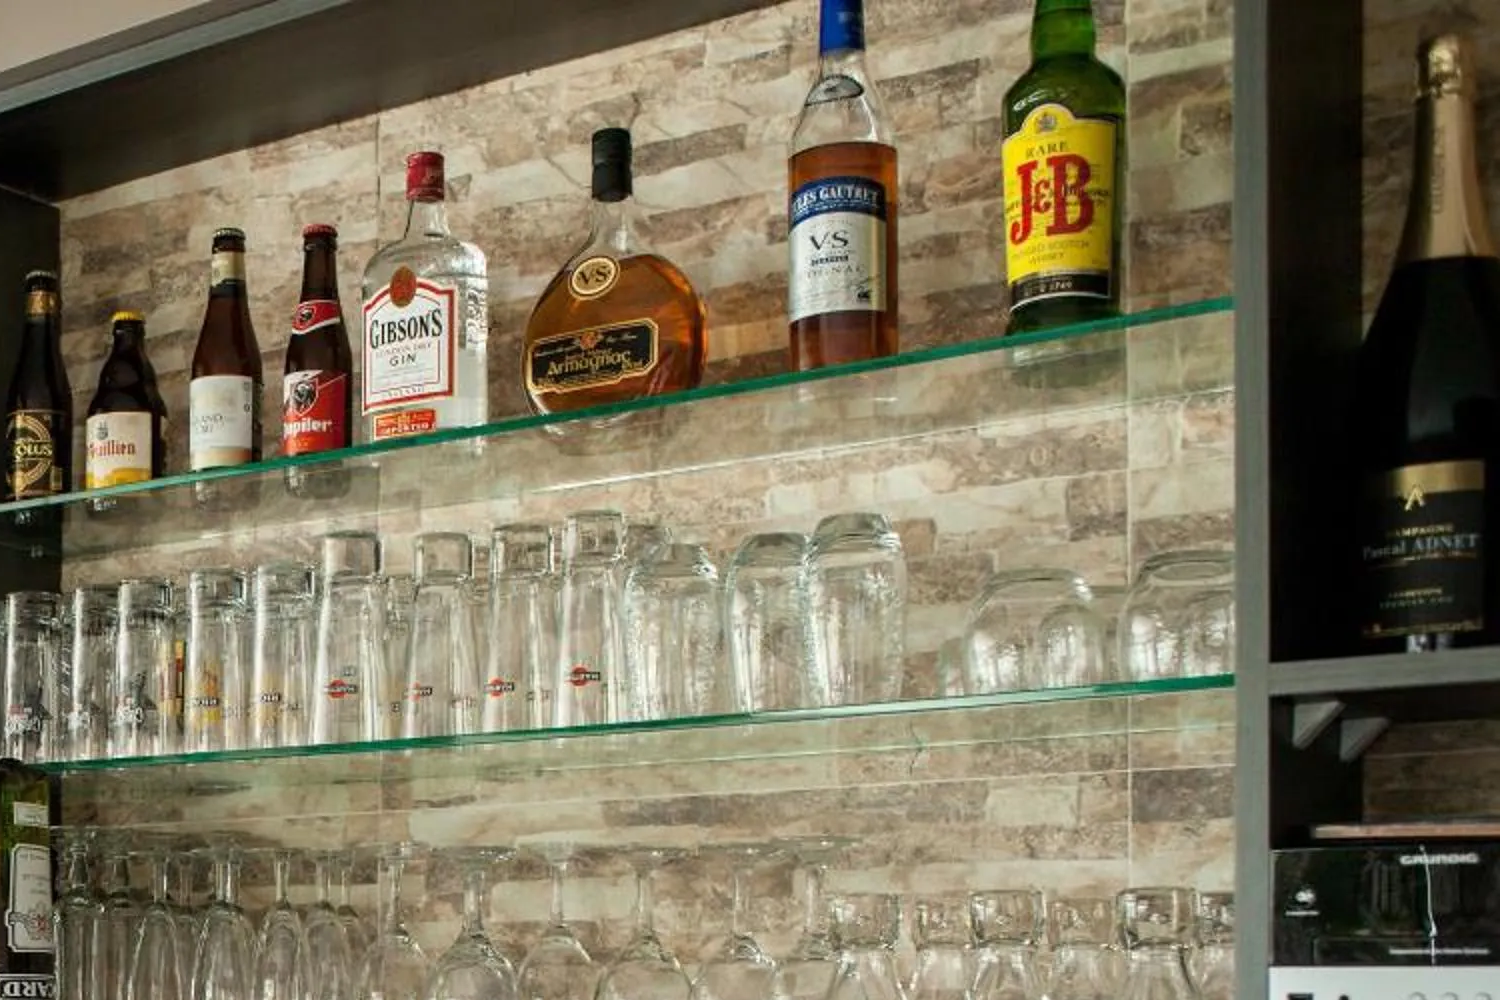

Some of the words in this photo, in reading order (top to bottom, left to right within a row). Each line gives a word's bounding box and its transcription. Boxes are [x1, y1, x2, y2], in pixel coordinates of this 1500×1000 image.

[1010, 154, 1094, 245] J&B
[389, 354, 417, 367] GIN
[547, 350, 631, 375] Armagnac
